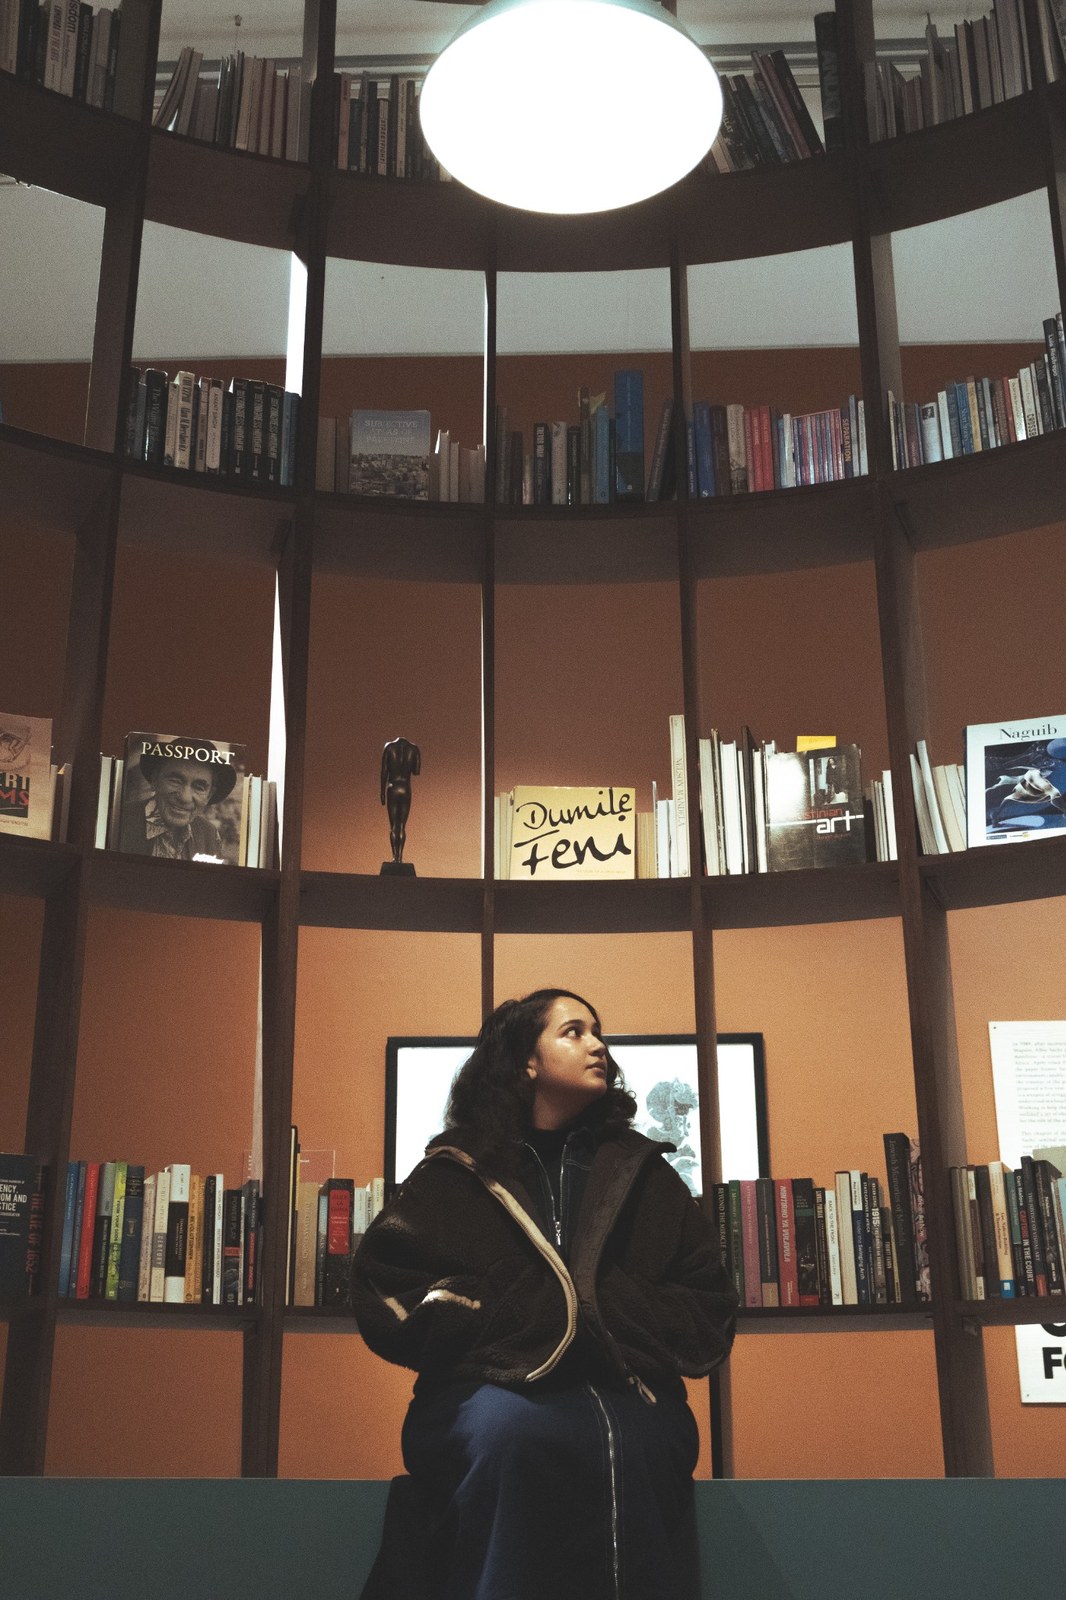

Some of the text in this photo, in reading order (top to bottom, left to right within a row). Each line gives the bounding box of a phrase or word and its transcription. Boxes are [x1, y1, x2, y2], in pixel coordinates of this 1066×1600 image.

[1050, 348, 1058, 377] Restrepo
[842, 418, 852, 462] SEPARATION
[1000, 724, 1057, 740] Naguib
[141, 741, 236, 766] PASSPORT
[0, 771, 30, 790] RT
[515, 786, 632, 829] Dumile
[677, 789, 685, 827] MANDELA
[816, 809, 856, 834] art
[888, 1140, 898, 1165] Jewish
[891, 1166, 902, 1202] Memories
[1017, 1187, 1025, 1206] Mafora
[0, 1193, 28, 1203] OM AND
[895, 1203, 903, 1212] of
[782, 1219, 789, 1228] YA
[871, 1208, 880, 1227] 1915:
[1019, 1210, 1029, 1239] CAPTURE
[1031, 1222, 1037, 1231] OF
[25, 1193, 44, 1273] THE LIE OF 1652
[156, 1235, 164, 1265] CENTURY
[1023, 1247, 1031, 1260] THE
[1025, 1260, 1034, 1283] COURT
[1042, 1347, 1066, 1379] F
